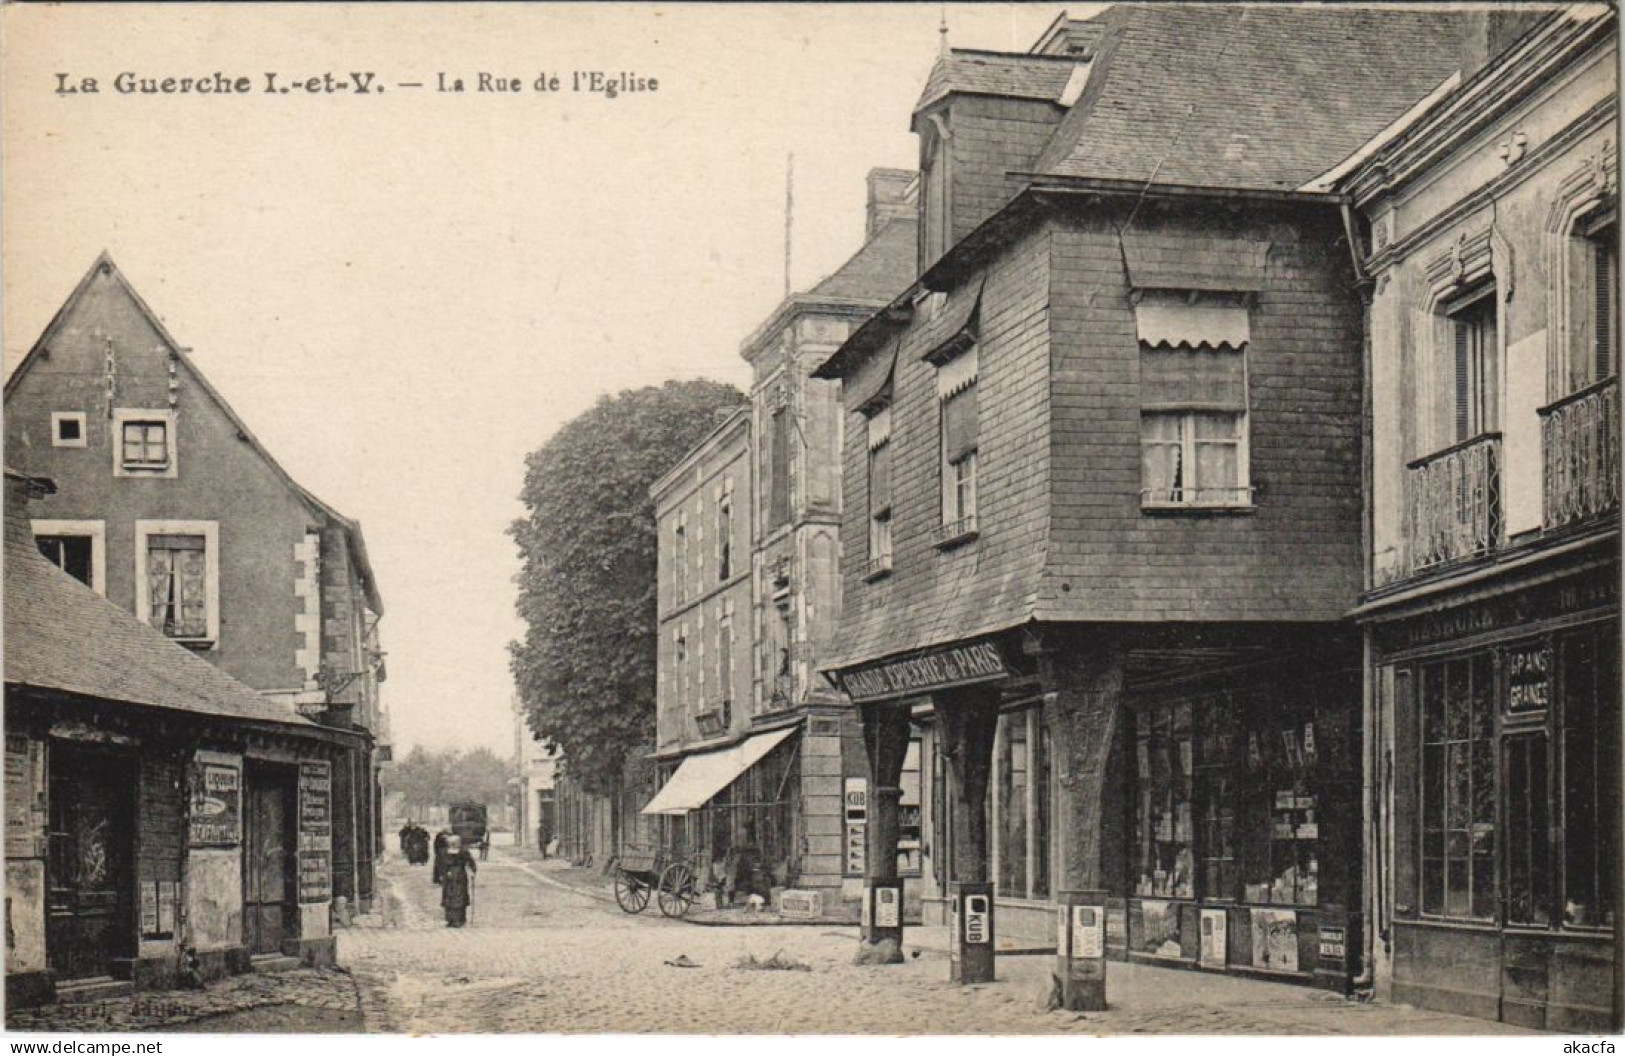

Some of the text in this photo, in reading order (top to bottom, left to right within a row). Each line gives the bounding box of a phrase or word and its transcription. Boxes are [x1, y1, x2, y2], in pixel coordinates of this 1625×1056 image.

[952, 642, 1003, 677] PARIS
[847, 791, 865, 806] KUB
[967, 914, 983, 942] KUB
